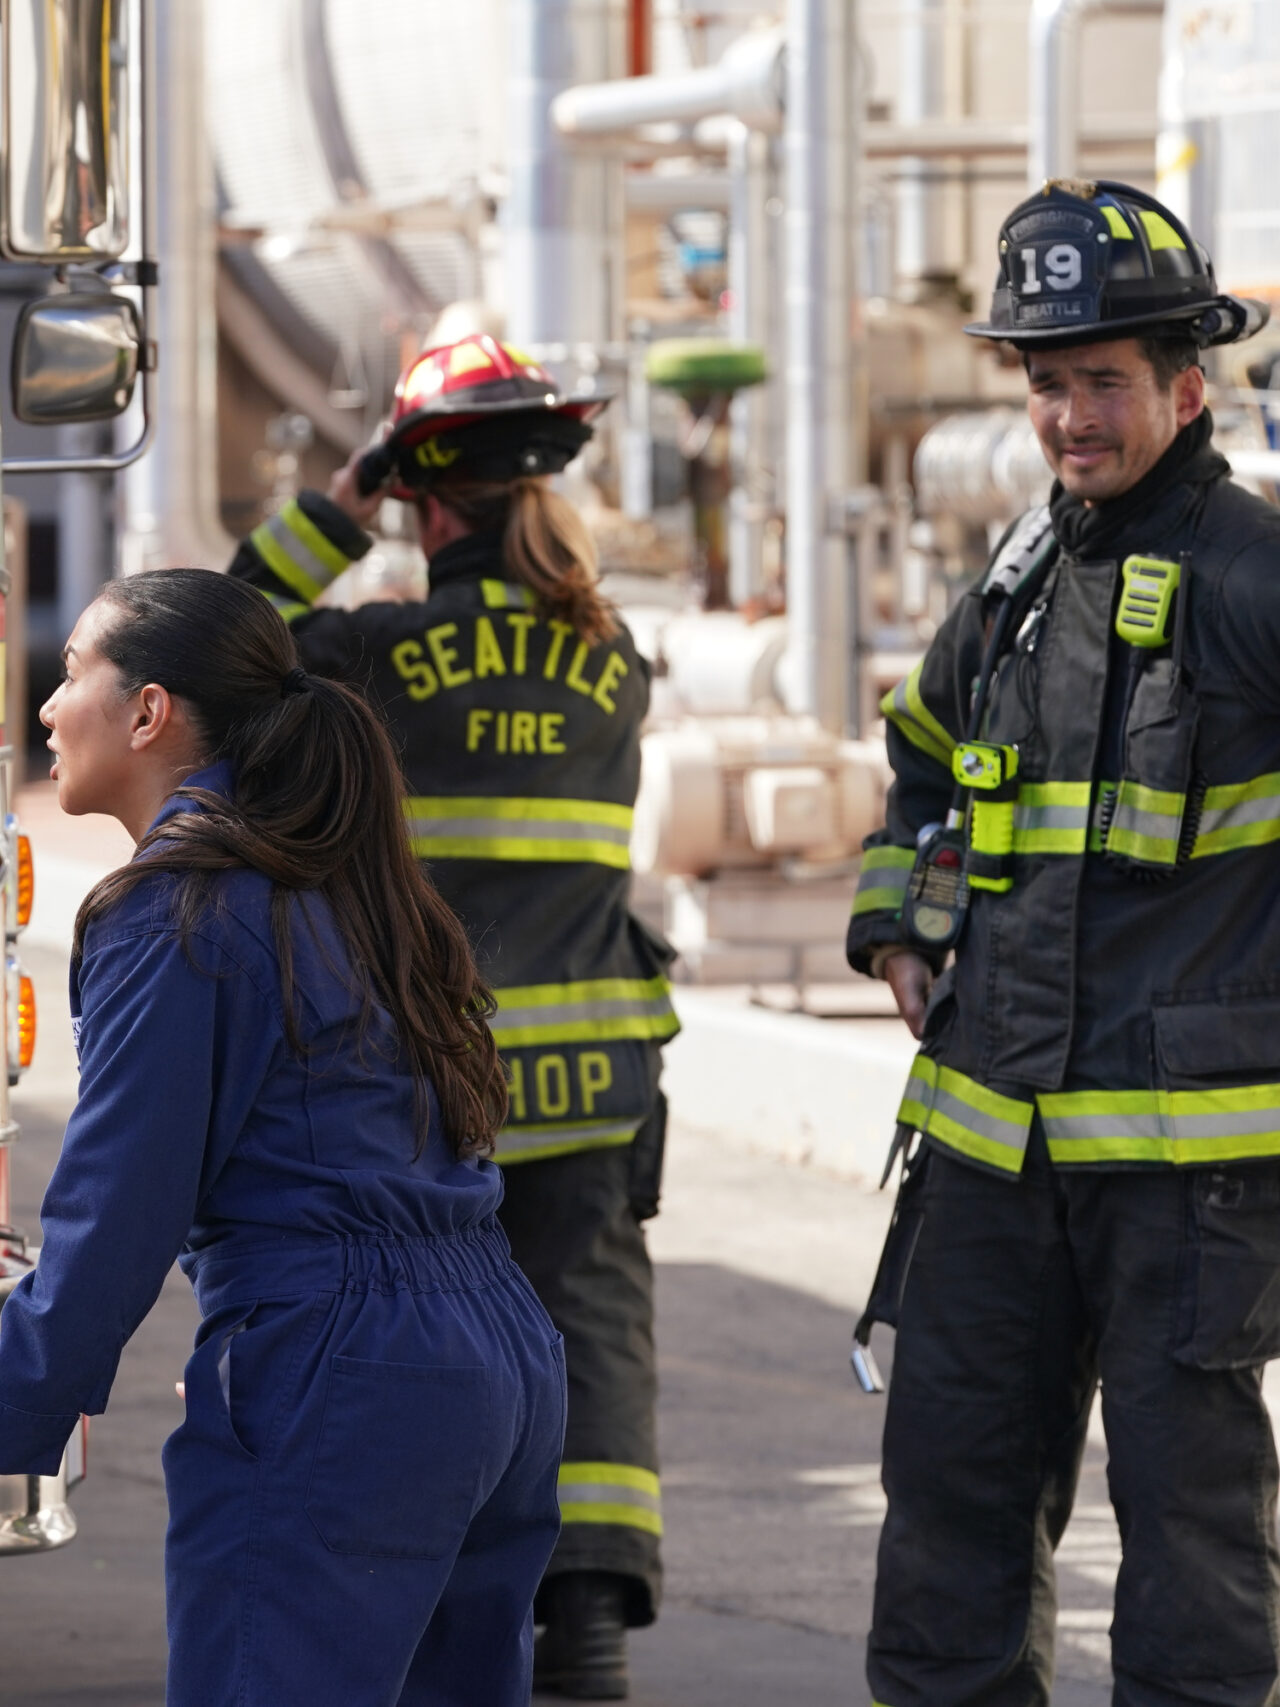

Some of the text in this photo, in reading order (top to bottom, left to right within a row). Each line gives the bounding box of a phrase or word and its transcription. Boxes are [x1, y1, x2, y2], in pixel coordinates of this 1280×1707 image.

[1022, 244, 1082, 294] 19
[1022, 301, 1082, 318] SEATTLE
[391, 613, 628, 715] SEATTLE
[467, 708, 566, 754] FIRE
